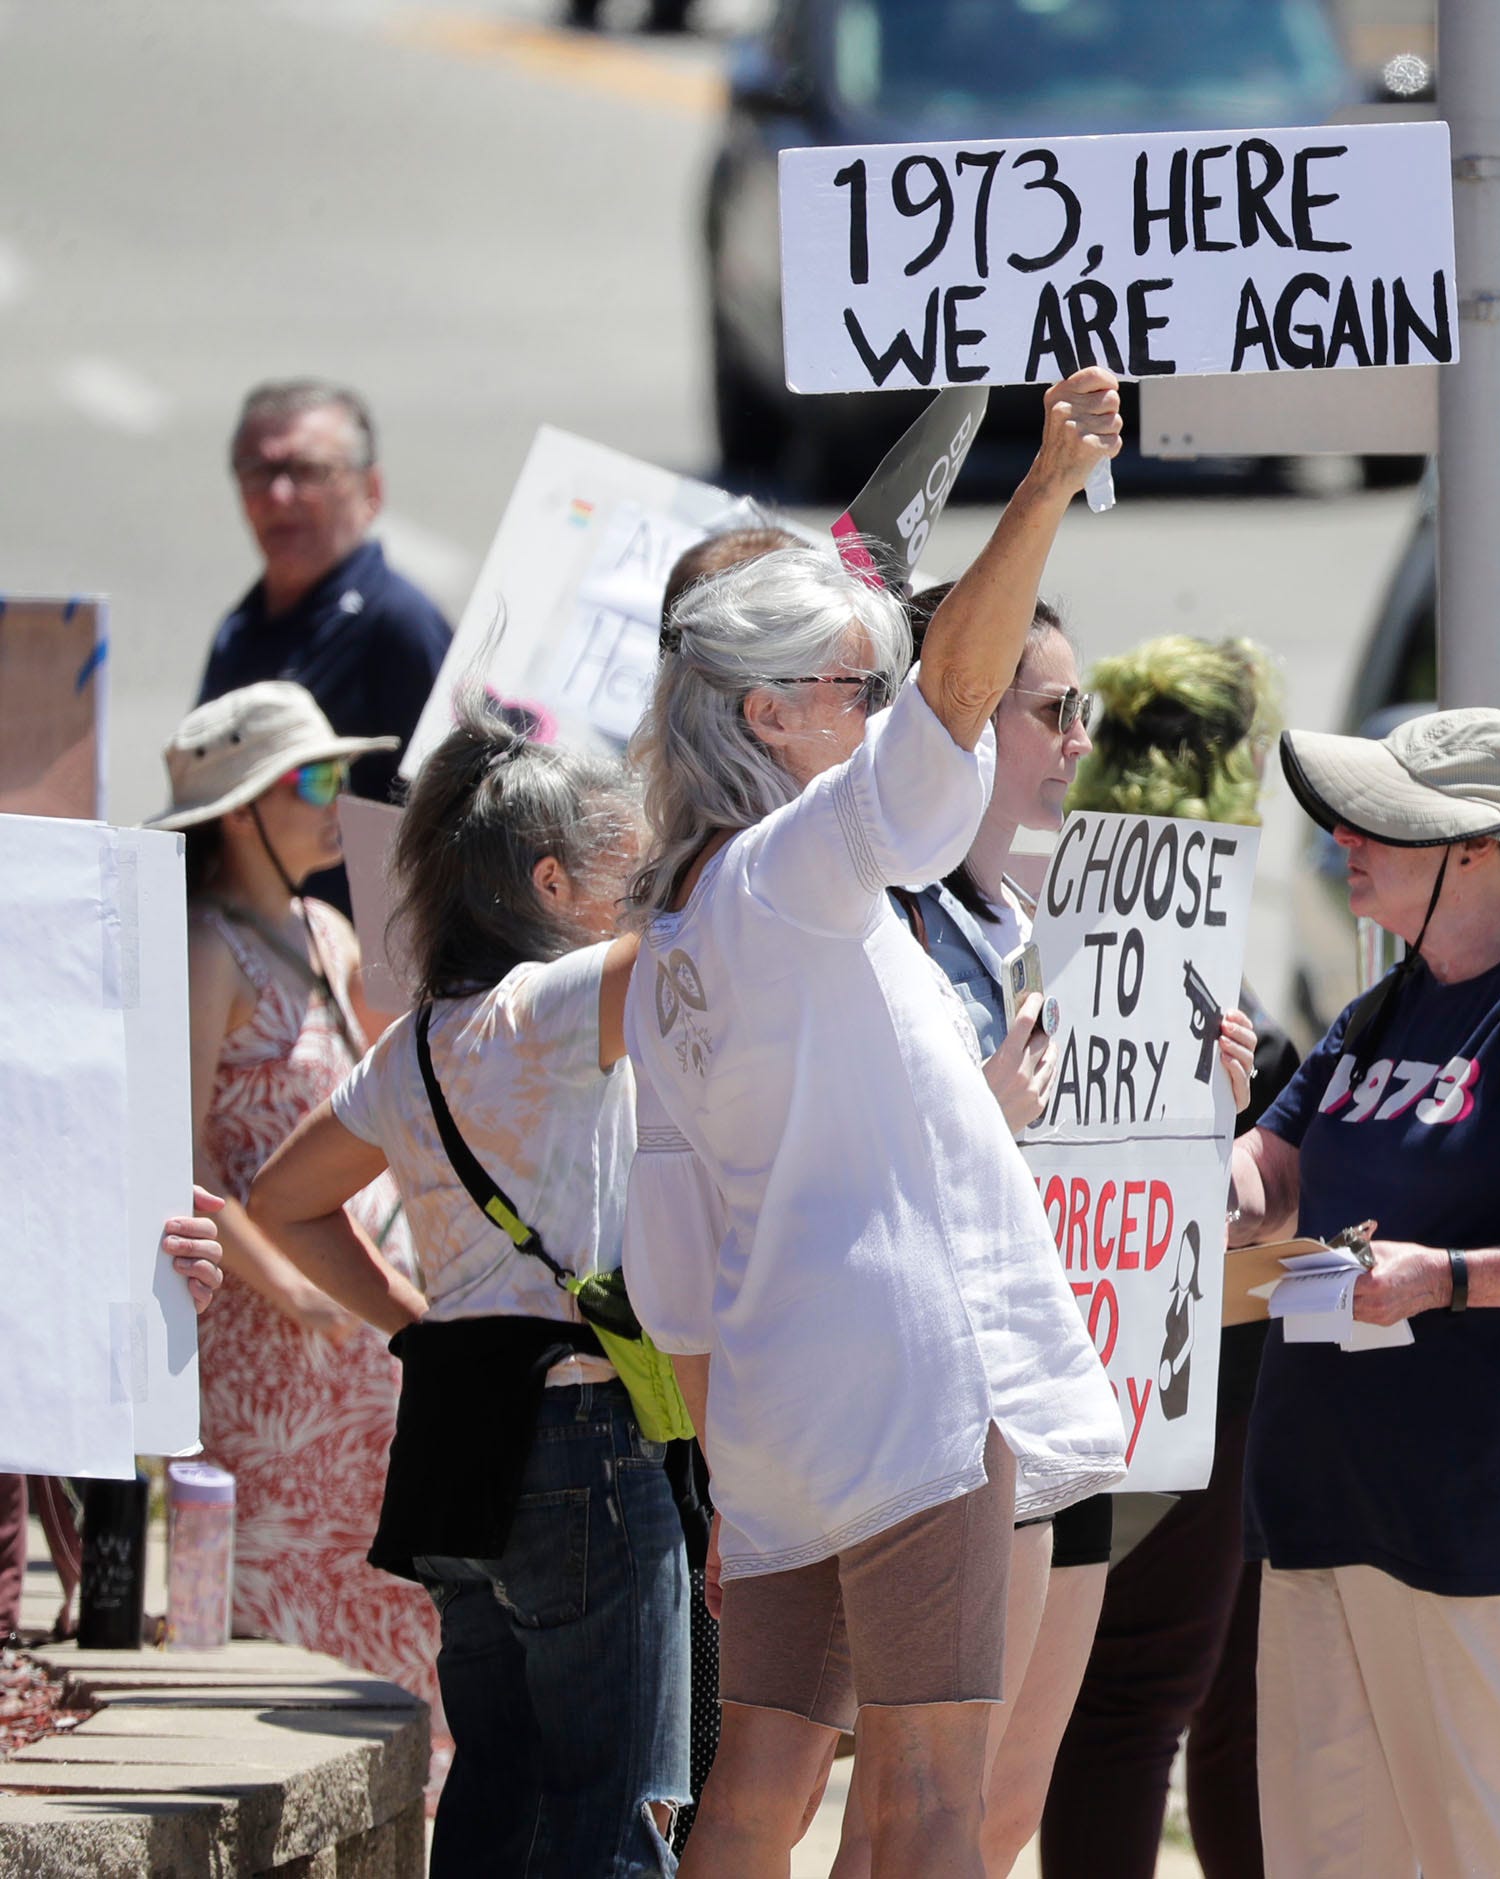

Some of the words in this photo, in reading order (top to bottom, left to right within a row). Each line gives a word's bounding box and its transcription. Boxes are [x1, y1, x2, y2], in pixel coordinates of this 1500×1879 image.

[833, 149, 1104, 285] 1973,
[1133, 138, 1352, 256] HERE
[843, 285, 991, 387] WE
[1025, 278, 1176, 382] ARE
[1230, 269, 1452, 372] AGAIN
[1047, 817, 1238, 929] CHOOSE
[1084, 927, 1145, 1018] TO
[1027, 1026, 1170, 1130] ARRY,
[1318, 1053, 1480, 1125] 1973
[1035, 1174, 1174, 1272] ORCED
